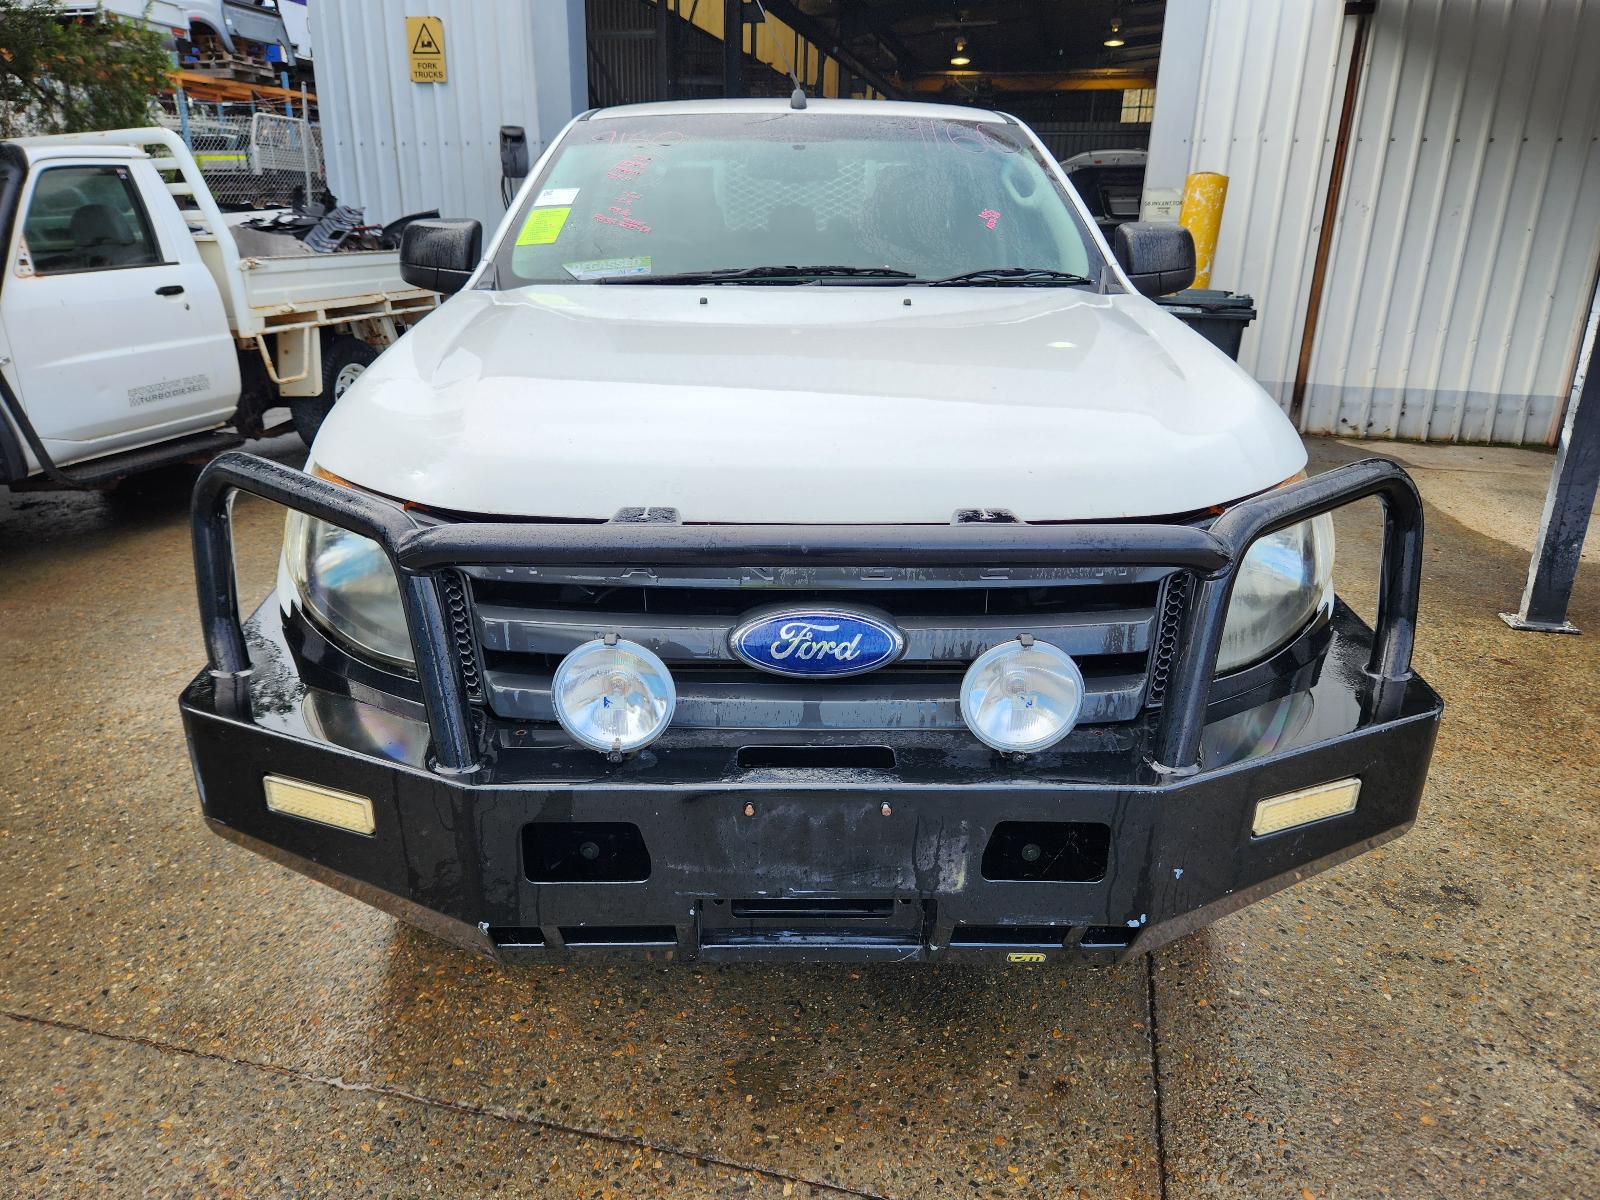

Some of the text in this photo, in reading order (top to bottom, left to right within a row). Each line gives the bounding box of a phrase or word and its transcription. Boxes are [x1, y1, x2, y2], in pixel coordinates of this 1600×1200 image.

[417, 62, 438, 70] FORK
[414, 71, 444, 79] TRUCKS
[572, 258, 642, 272] DEGASSED
[770, 622, 863, 661] Ford
